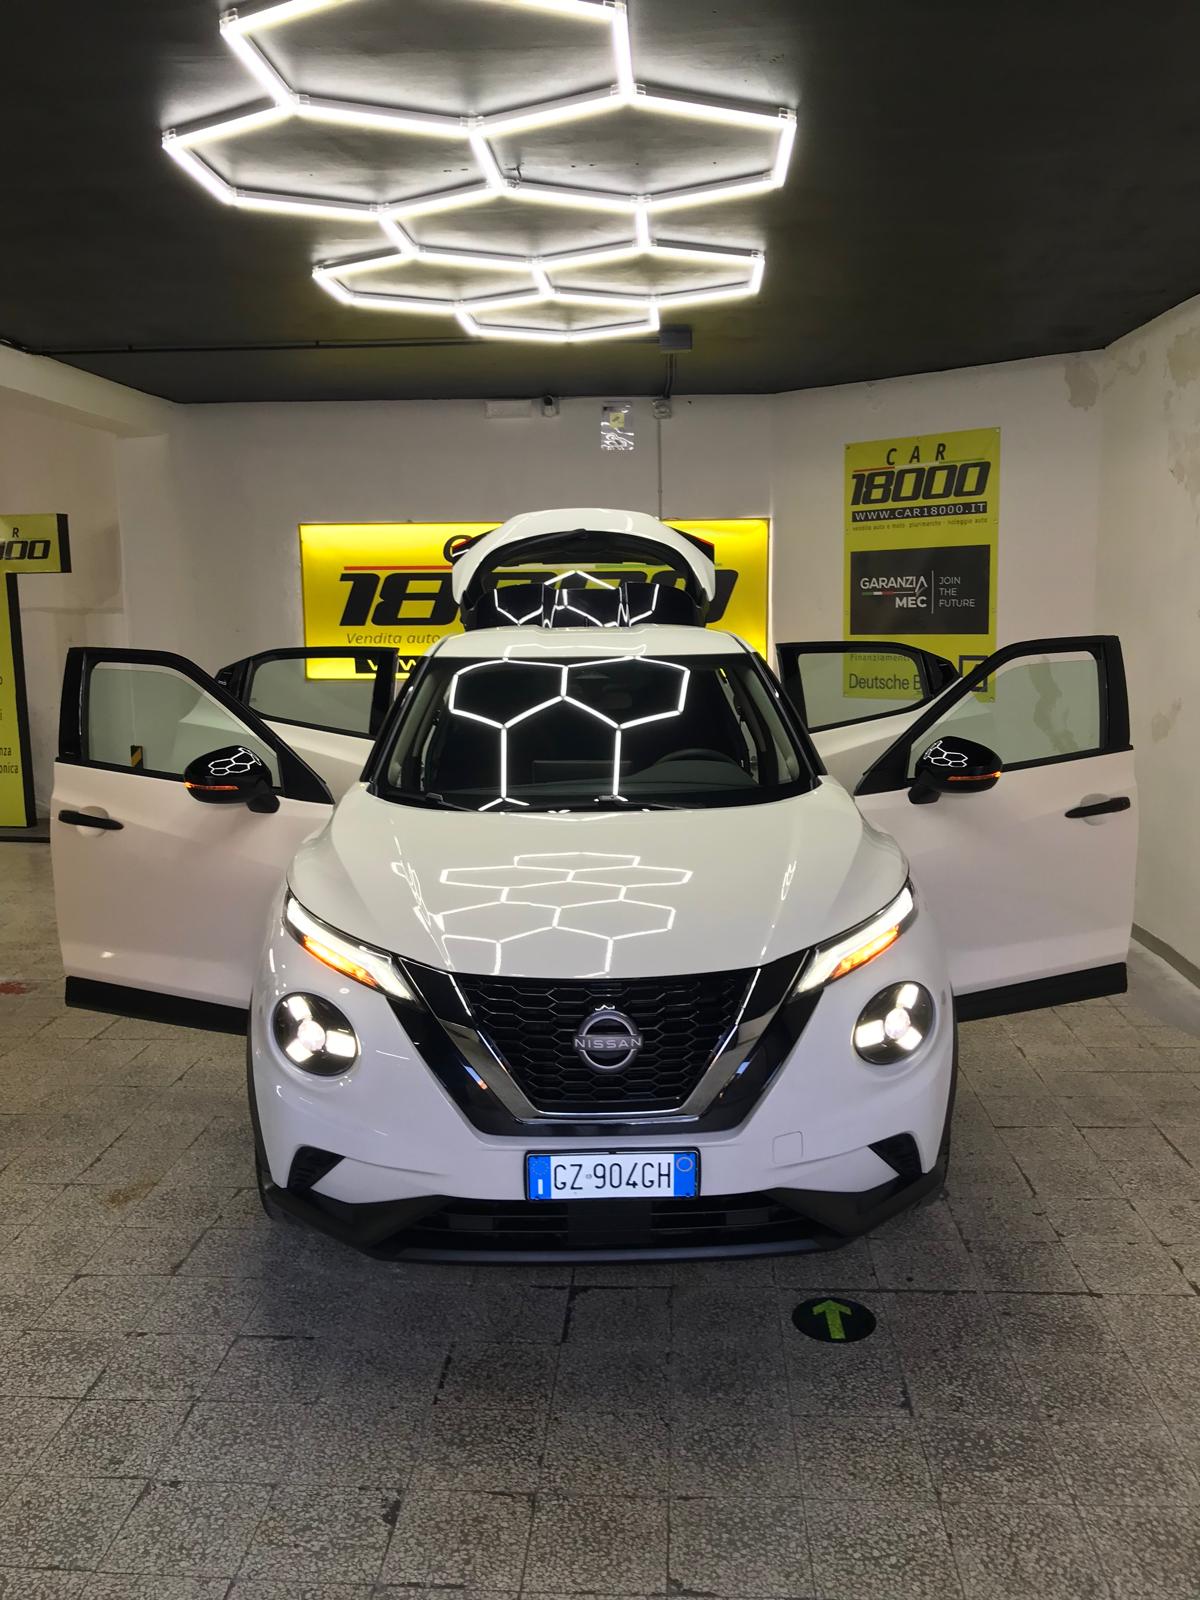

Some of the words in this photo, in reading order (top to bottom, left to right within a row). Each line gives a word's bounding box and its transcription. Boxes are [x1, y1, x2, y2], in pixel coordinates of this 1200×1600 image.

[850, 461, 991, 505] 18000
[855, 502, 986, 521] WWW.CAR18000.IT
[860, 576, 928, 592] GARANZIA
[939, 576, 961, 585] JOIN
[939, 587, 957, 596] THE
[895, 596, 928, 608] MEC
[939, 598, 975, 607] FUTURE
[346, 632, 402, 644] Vendita
[849, 673, 909, 690] Deutsche
[574, 1037, 642, 1049] NISSAN
